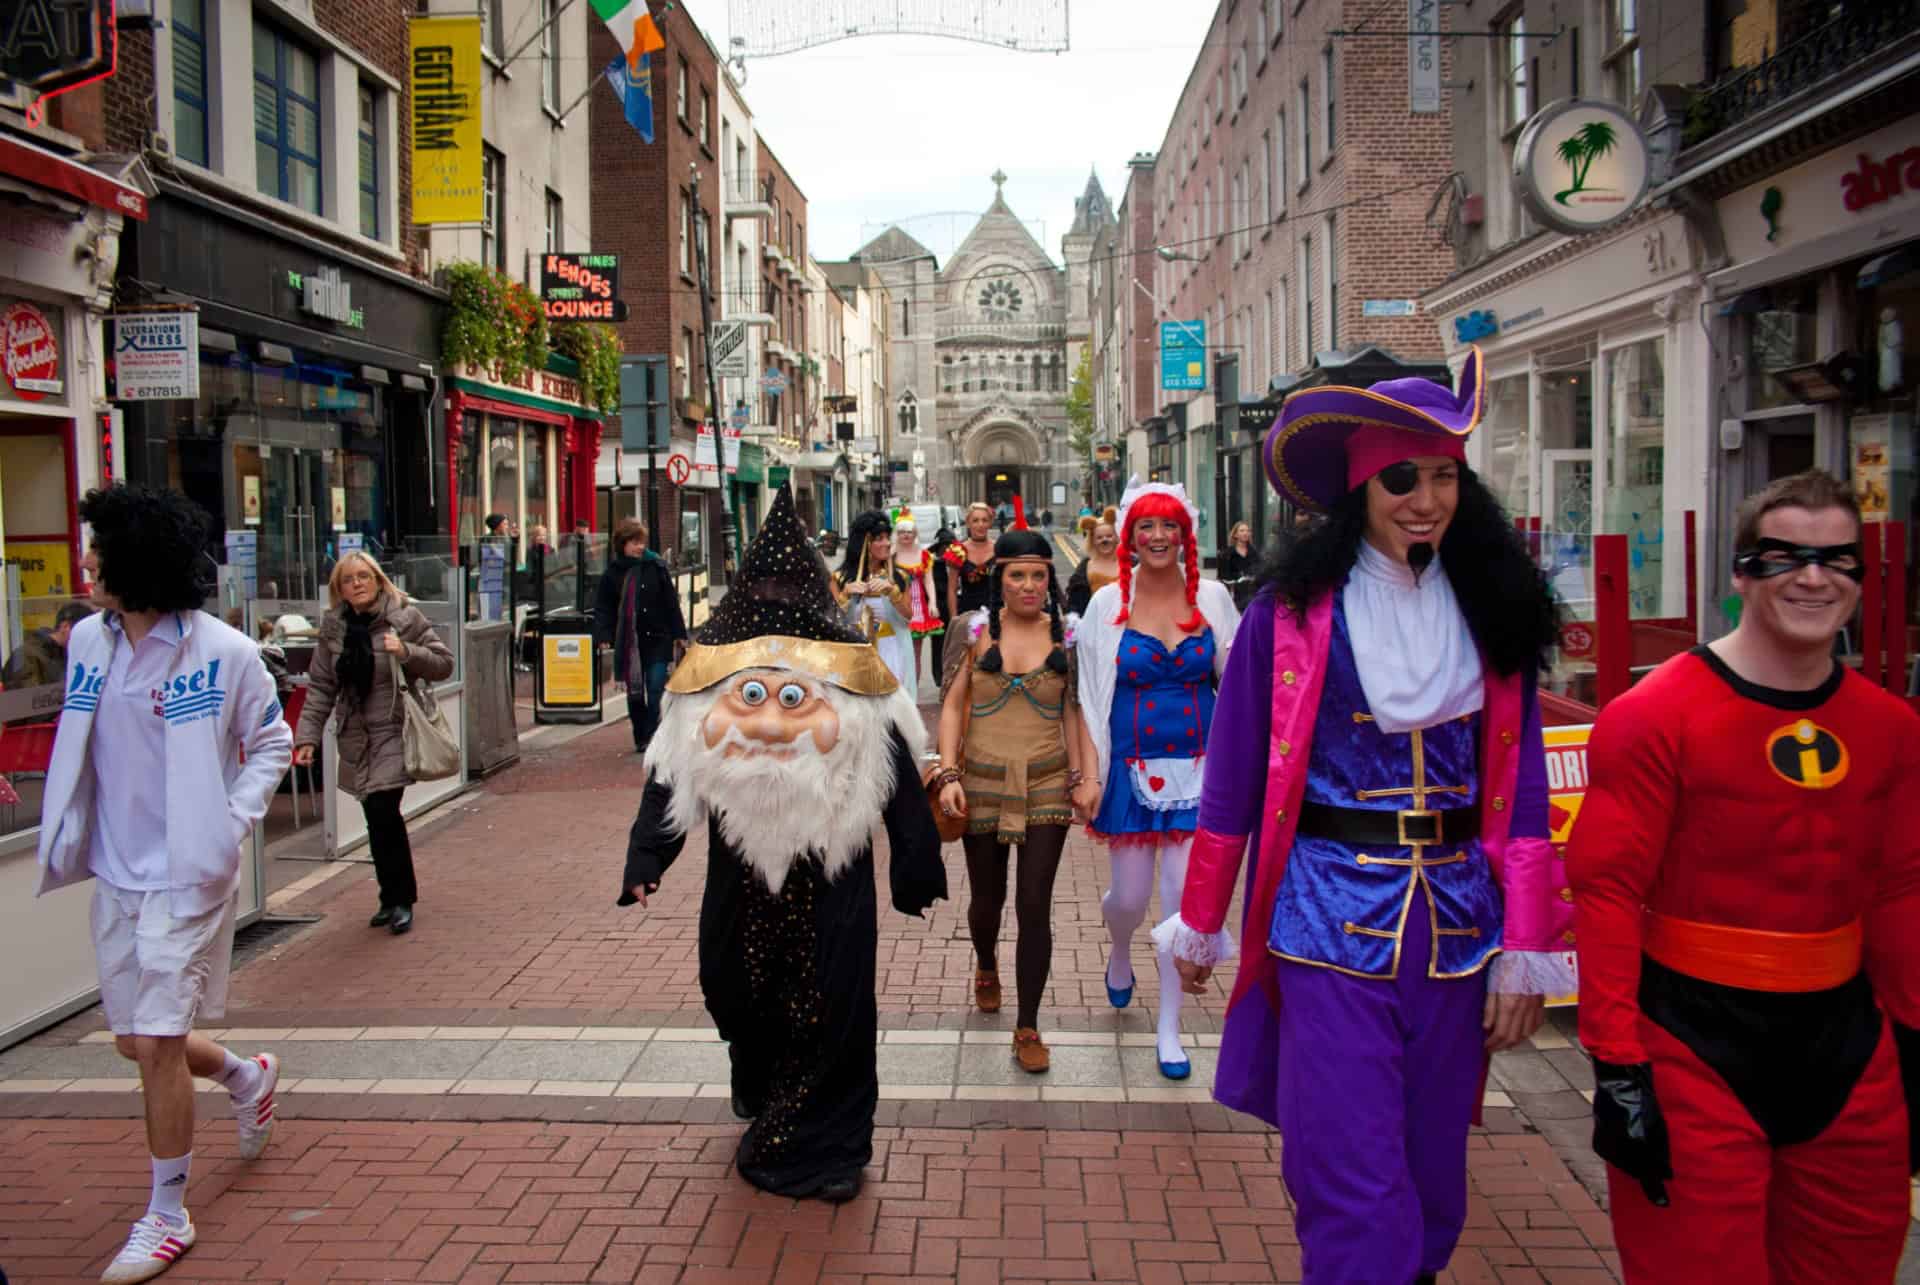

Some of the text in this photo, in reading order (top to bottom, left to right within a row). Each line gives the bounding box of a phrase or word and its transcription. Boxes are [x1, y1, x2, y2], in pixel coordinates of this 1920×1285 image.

[414, 46, 466, 150] GOTHAM
[579, 256, 616, 267] WINES
[547, 256, 611, 298] KEHOES
[543, 301, 614, 318] LOUNGE
[121, 324, 181, 335] ALTERATIONS
[138, 386, 181, 397] 6717813
